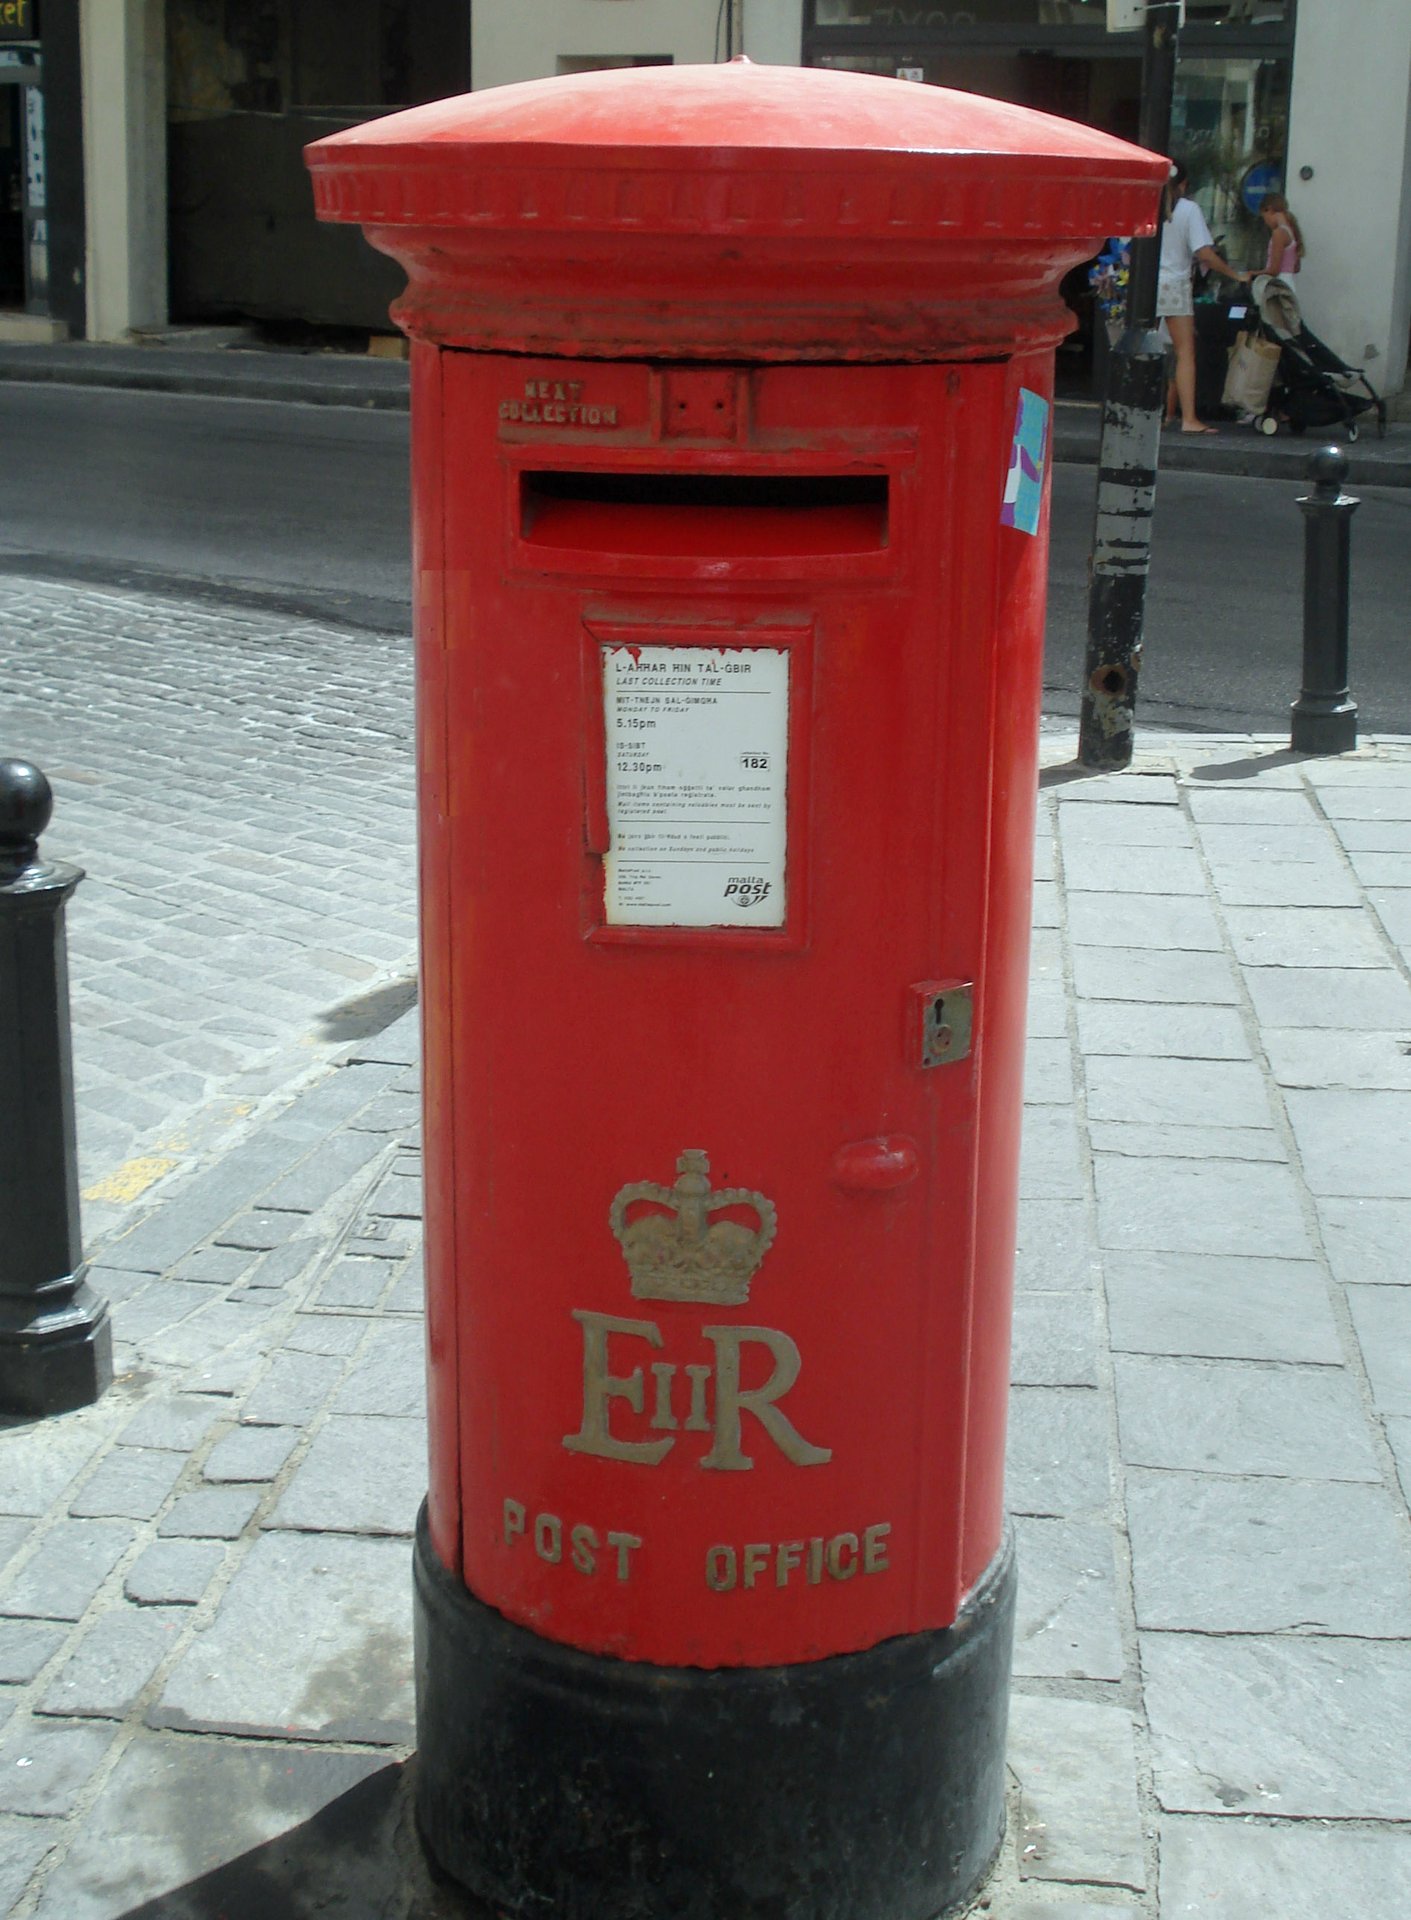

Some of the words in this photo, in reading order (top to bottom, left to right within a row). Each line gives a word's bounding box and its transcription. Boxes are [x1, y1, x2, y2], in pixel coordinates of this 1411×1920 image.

[525, 381, 582, 400] NEXT
[499, 402, 617, 424] COLLECTION
[616, 677, 639, 686] LAST
[641, 677, 698, 686] COLLECTION
[701, 678, 722, 686] TIME
[616, 718, 656, 730] 5.15pm
[616, 761, 663, 774] 12.30pm
[741, 758, 768, 769] 182
[728, 876, 764, 884] malta
[723, 881, 773, 897] post
[503, 1497, 642, 1580] POST
[706, 1521, 892, 1592] OFFICE
